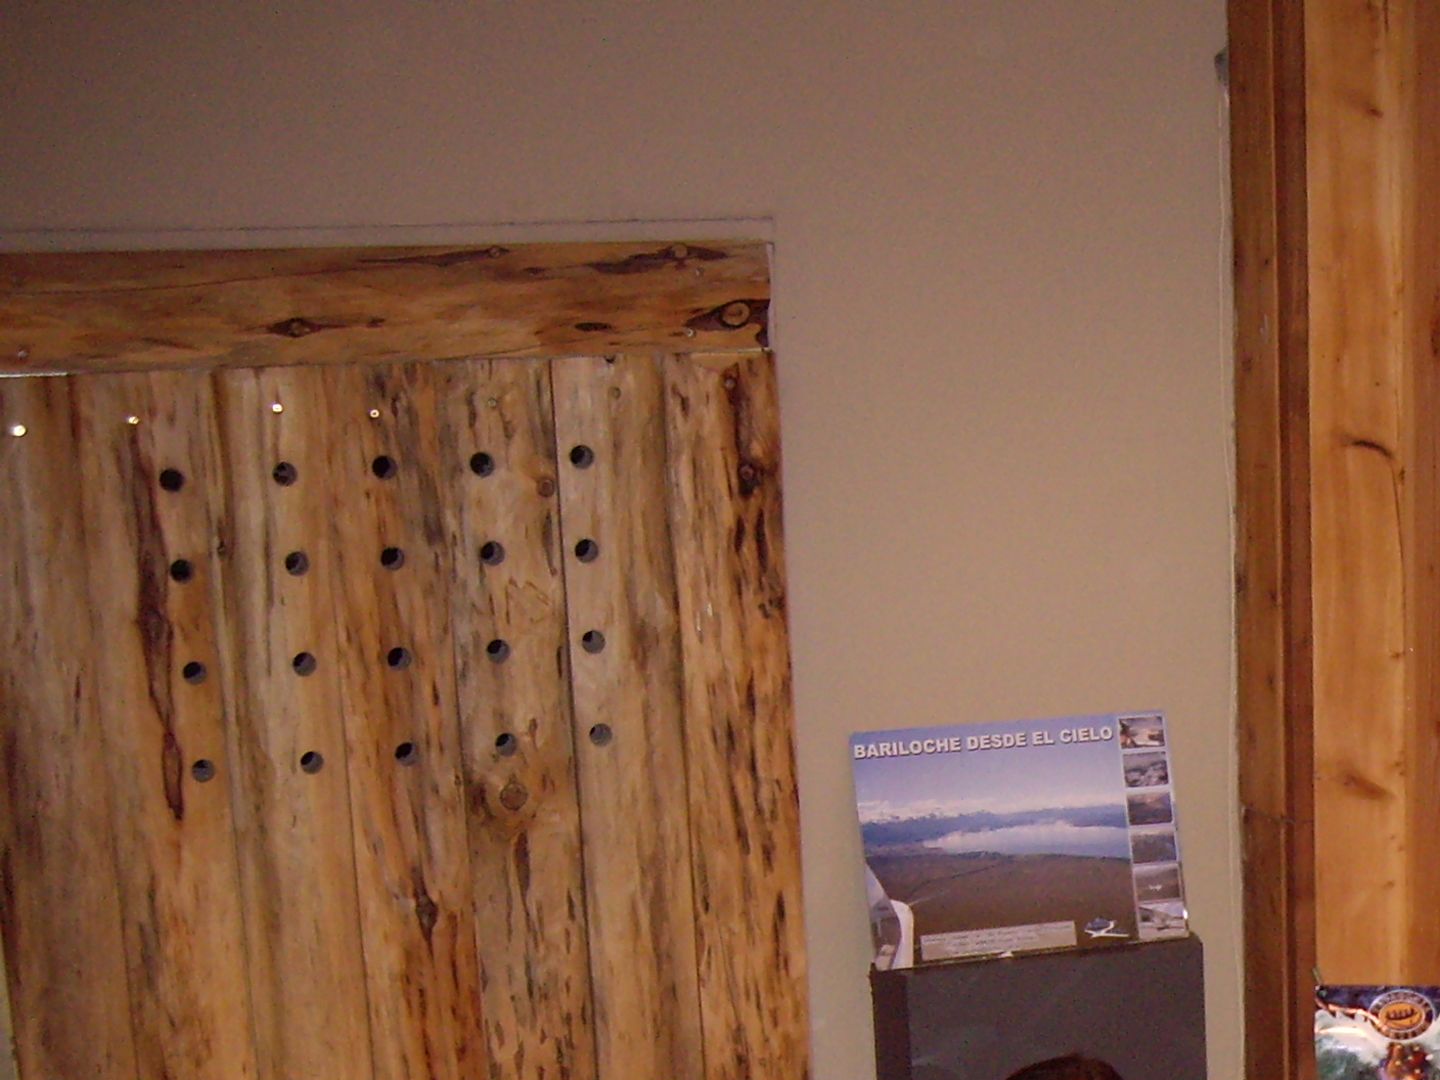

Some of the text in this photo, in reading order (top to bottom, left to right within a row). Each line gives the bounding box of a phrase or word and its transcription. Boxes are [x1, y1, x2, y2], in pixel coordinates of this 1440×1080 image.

[853, 725, 1114, 760] BARILOCHE DESDE EL CIELO
